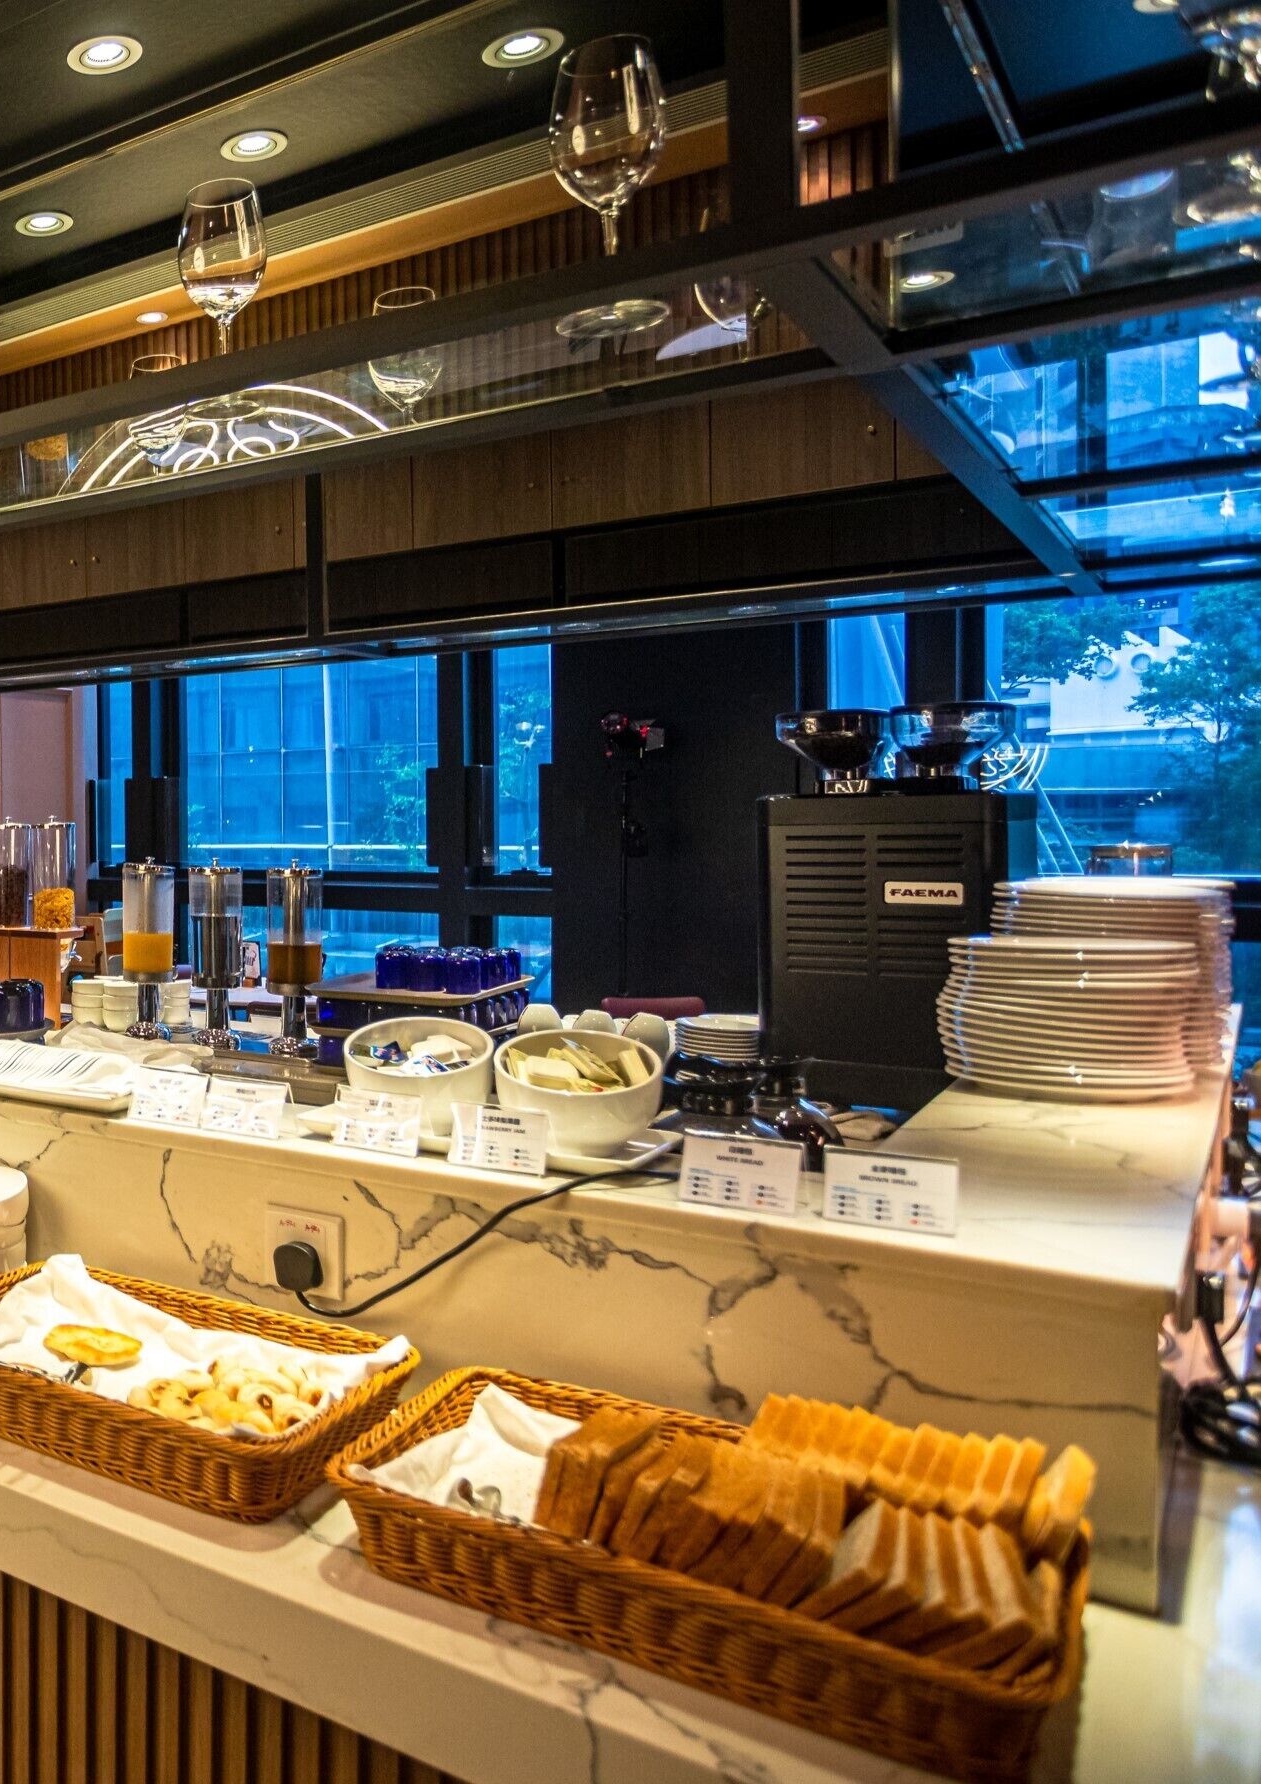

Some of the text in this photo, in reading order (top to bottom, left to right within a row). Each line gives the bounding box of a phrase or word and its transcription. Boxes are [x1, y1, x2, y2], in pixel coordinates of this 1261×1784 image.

[889, 888, 959, 898] FAEMA
[716, 1154, 764, 1166] WHITE BREAD
[858, 1174, 918, 1187] BROWN BREAD
